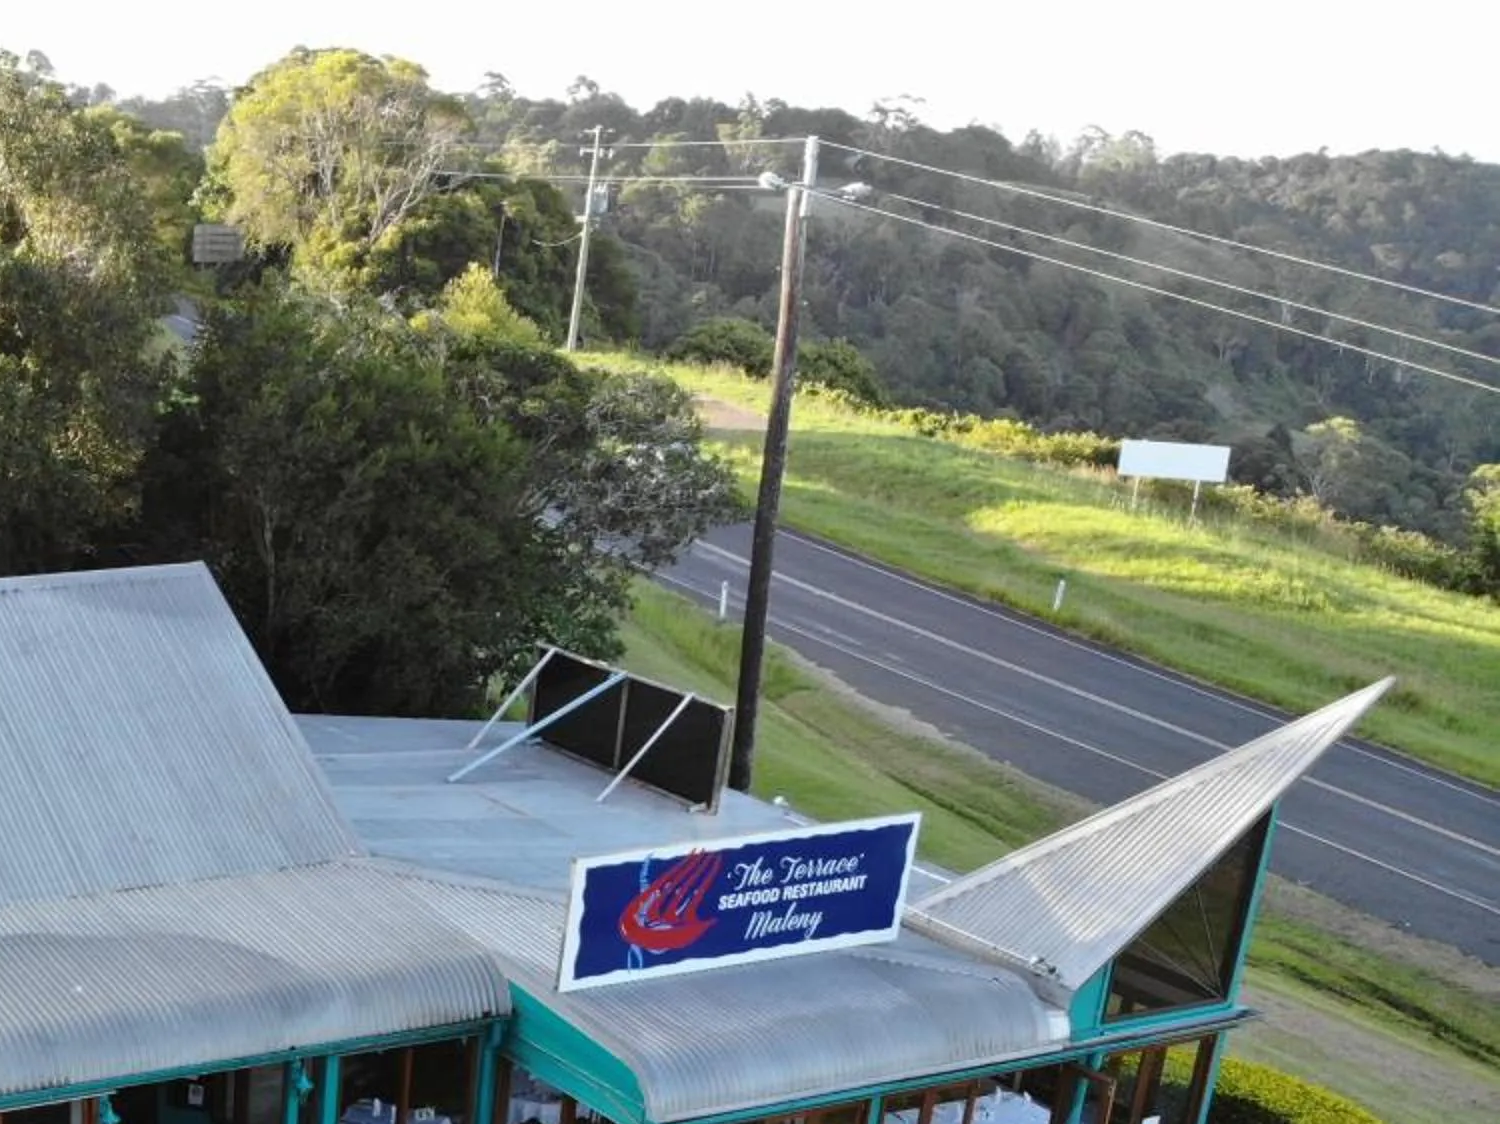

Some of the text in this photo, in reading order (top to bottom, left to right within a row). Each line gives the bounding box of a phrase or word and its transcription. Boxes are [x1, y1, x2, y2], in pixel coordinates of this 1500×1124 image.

[718, 875, 868, 911] SEAFOOD RESTAURANT
[744, 902, 824, 940] Maleny
